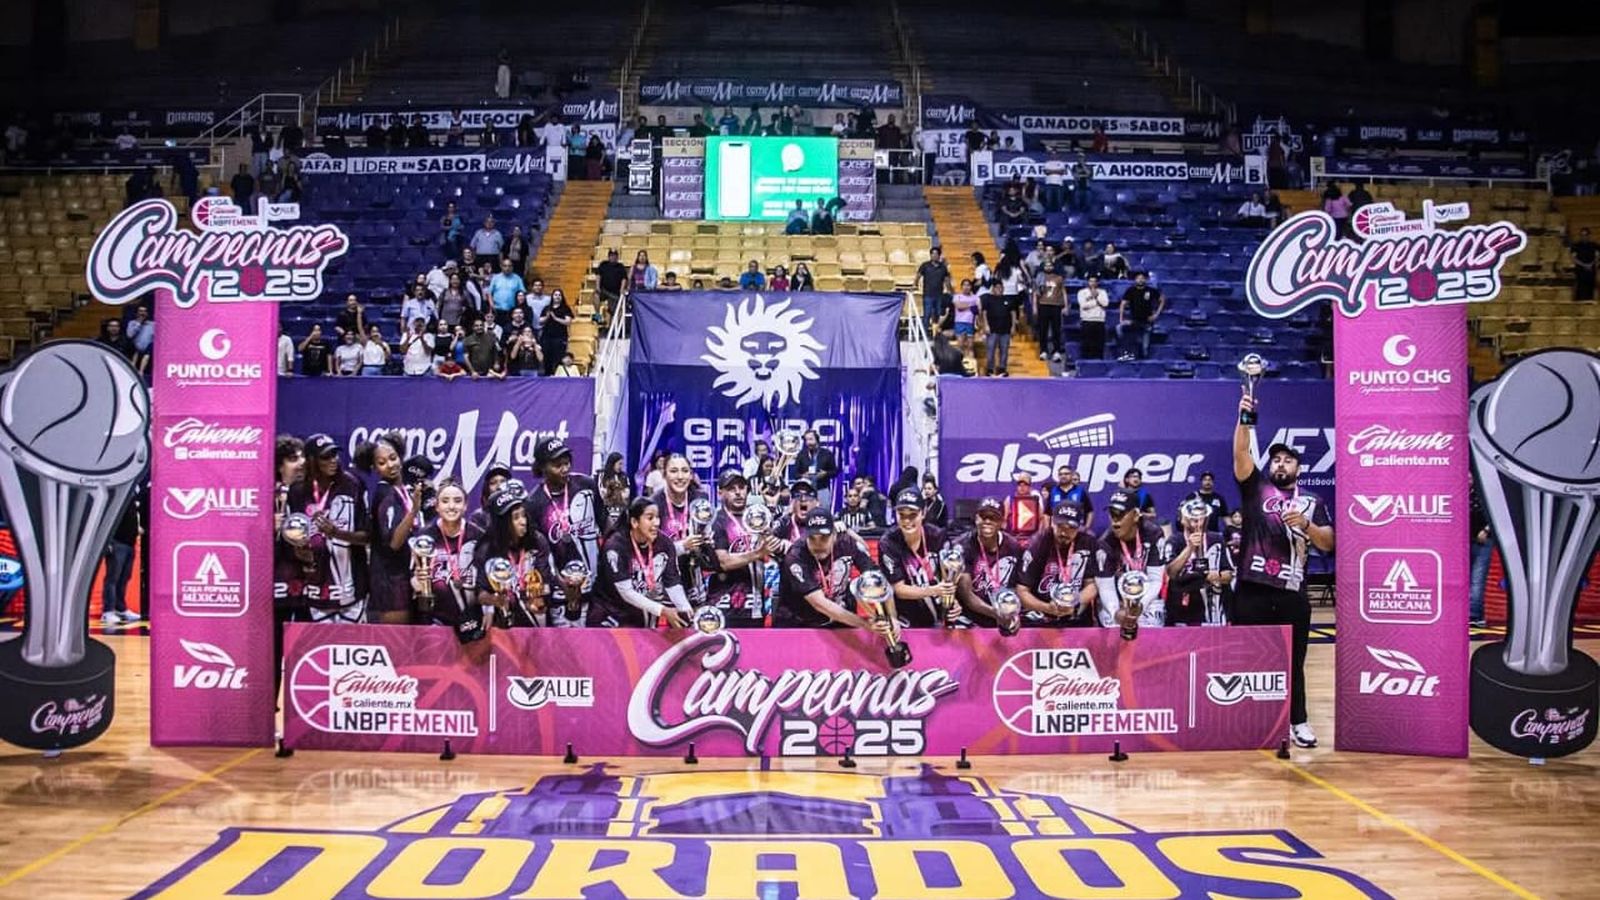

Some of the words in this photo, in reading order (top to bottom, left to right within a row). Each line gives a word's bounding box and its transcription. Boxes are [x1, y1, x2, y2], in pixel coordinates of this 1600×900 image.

[462, 112, 524, 127] NEGOCI
[1130, 118, 1181, 132] SABOR
[418, 158, 481, 172] SABOR
[487, 154, 545, 174] carneMart
[840, 160, 872, 168] EXBET
[977, 165, 988, 178] B
[1109, 164, 1186, 178] AHORROS
[1189, 162, 1244, 184] carneMart
[840, 177, 872, 186] EXBET
[1251, 169, 1261, 182] B
[840, 193, 872, 202] EXBET
[840, 210, 873, 219] EXBET
[95, 203, 343, 295] Campeonas
[1255, 215, 1520, 305] Campeonas
[213, 270, 318, 297] 2025
[1381, 271, 1495, 306] 2025
[166, 364, 225, 379] PUNTO
[226, 364, 262, 379] CHG
[1349, 370, 1411, 385] PUNTO
[1413, 370, 1452, 385] CHG
[163, 417, 263, 449] Caliente
[1347, 424, 1454, 455] Caliente
[956, 442, 1204, 494] alsuper
[1375, 455, 1450, 466] caliente.mx
[166, 487, 260, 513] VALUE
[1352, 494, 1453, 520] VALUE
[183, 594, 241, 604] MEXICANA
[1368, 601, 1432, 610] MEXICANA
[1393, 592, 1432, 601] POPULAR
[332, 650, 388, 672] LIGA
[1035, 650, 1092, 670] LIGA
[174, 664, 249, 690] Voit
[333, 671, 416, 698] Caliente
[1036, 674, 1117, 701] Caliente
[1211, 674, 1286, 698] VALUE
[1360, 671, 1441, 697] Voit
[511, 678, 592, 703] VALUE
[626, 630, 962, 755] Campeonas
[353, 699, 413, 710] caliente.mx
[1056, 701, 1116, 713] caliente.mx
[333, 712, 477, 736] LNBPFEMENIL
[1036, 711, 1178, 734] LNBPFEMENIL
[781, 719, 924, 756] 2025
[130, 830, 1390, 900] DORADOS
